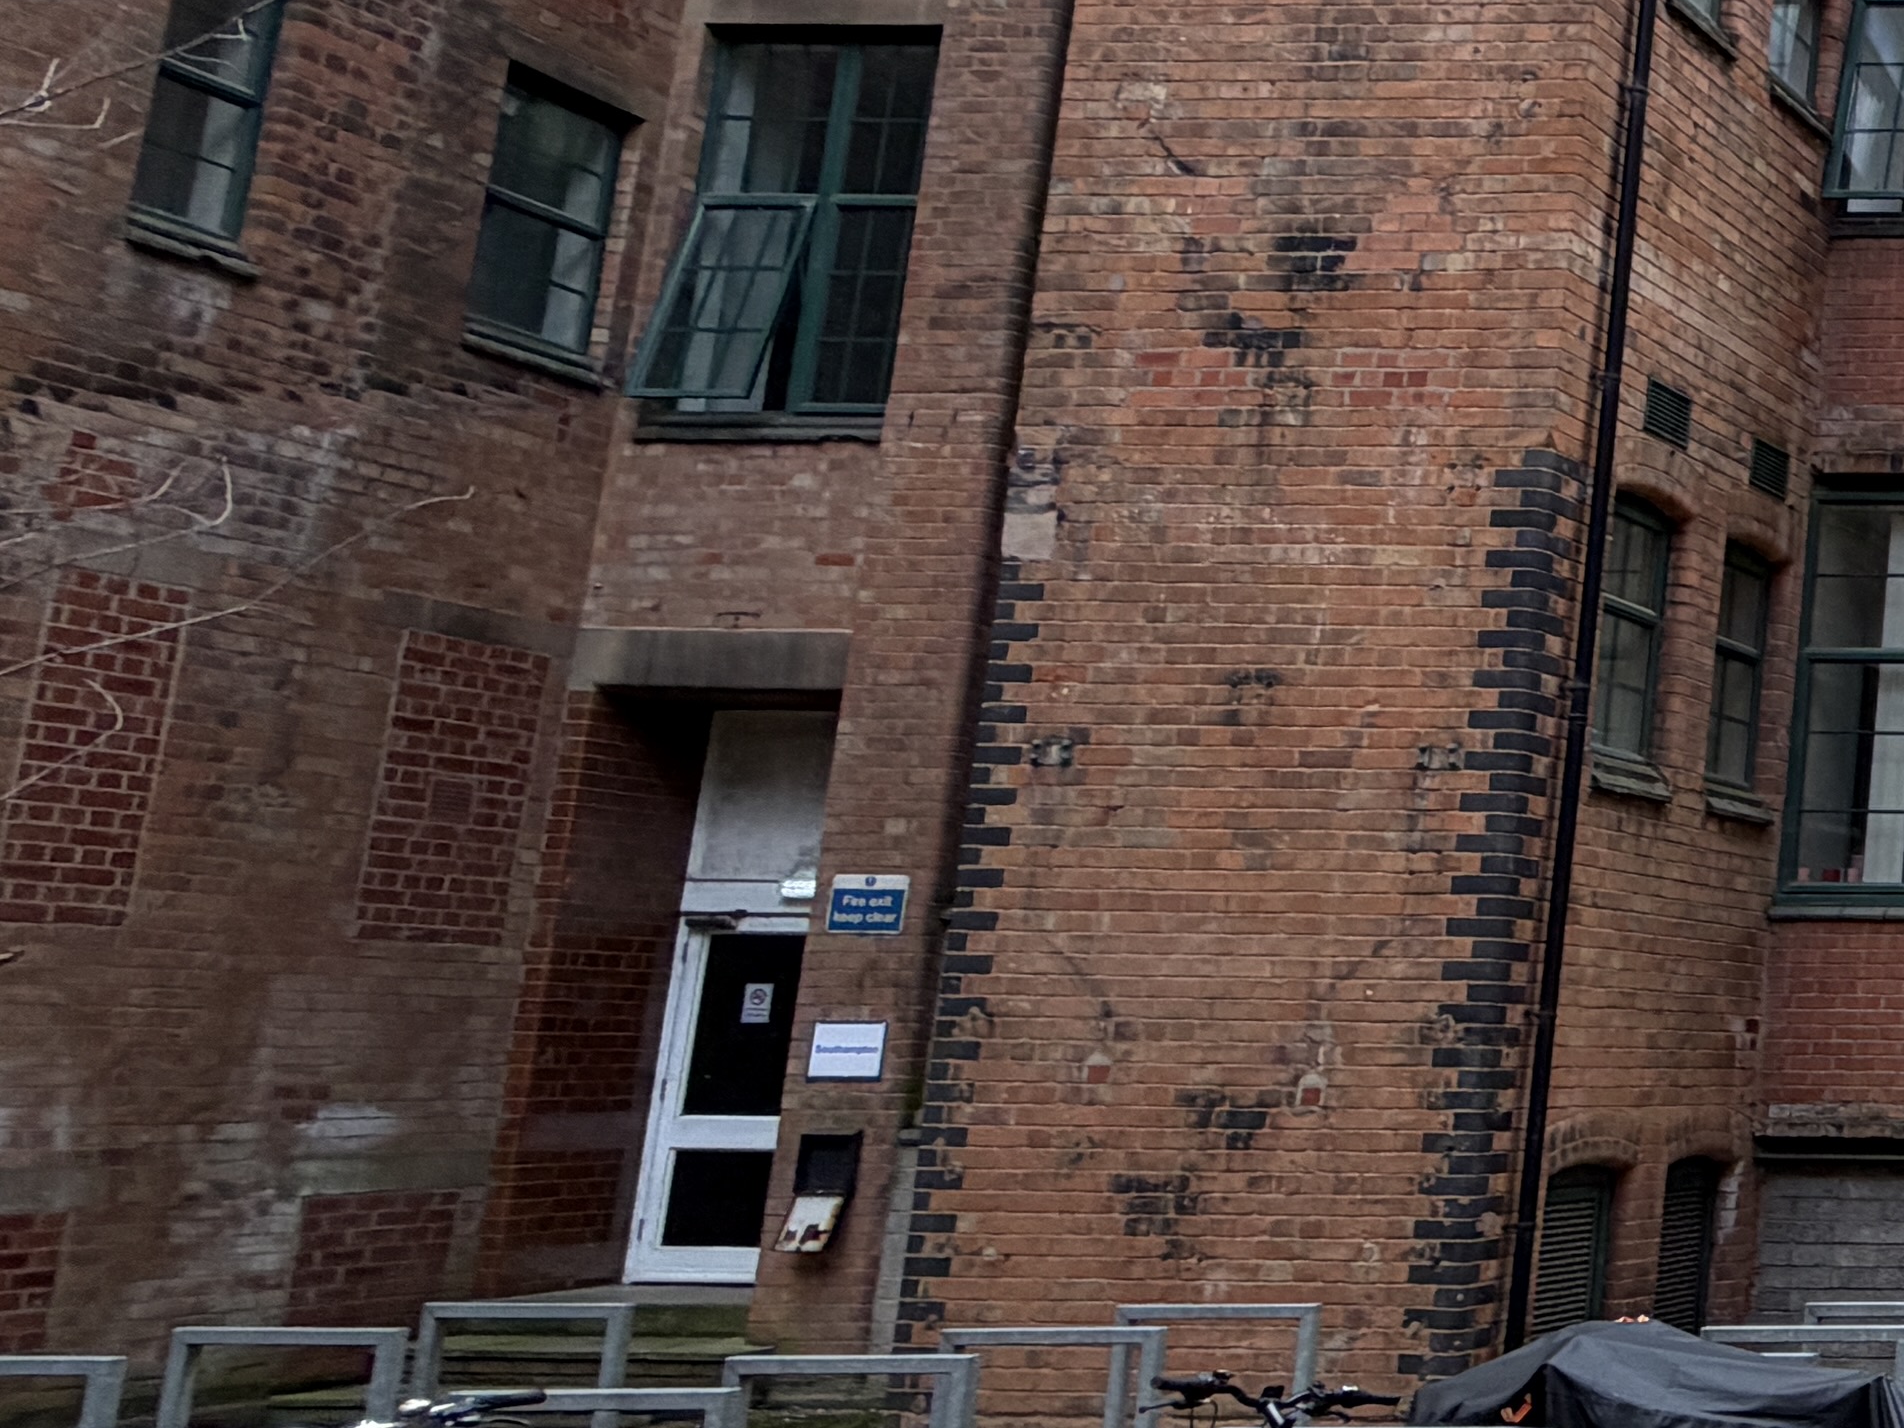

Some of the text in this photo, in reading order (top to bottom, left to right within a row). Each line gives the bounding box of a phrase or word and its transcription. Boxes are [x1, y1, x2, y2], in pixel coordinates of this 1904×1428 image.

[842, 895, 893, 907] Fire exit
[833, 911, 897, 924] keep clear
